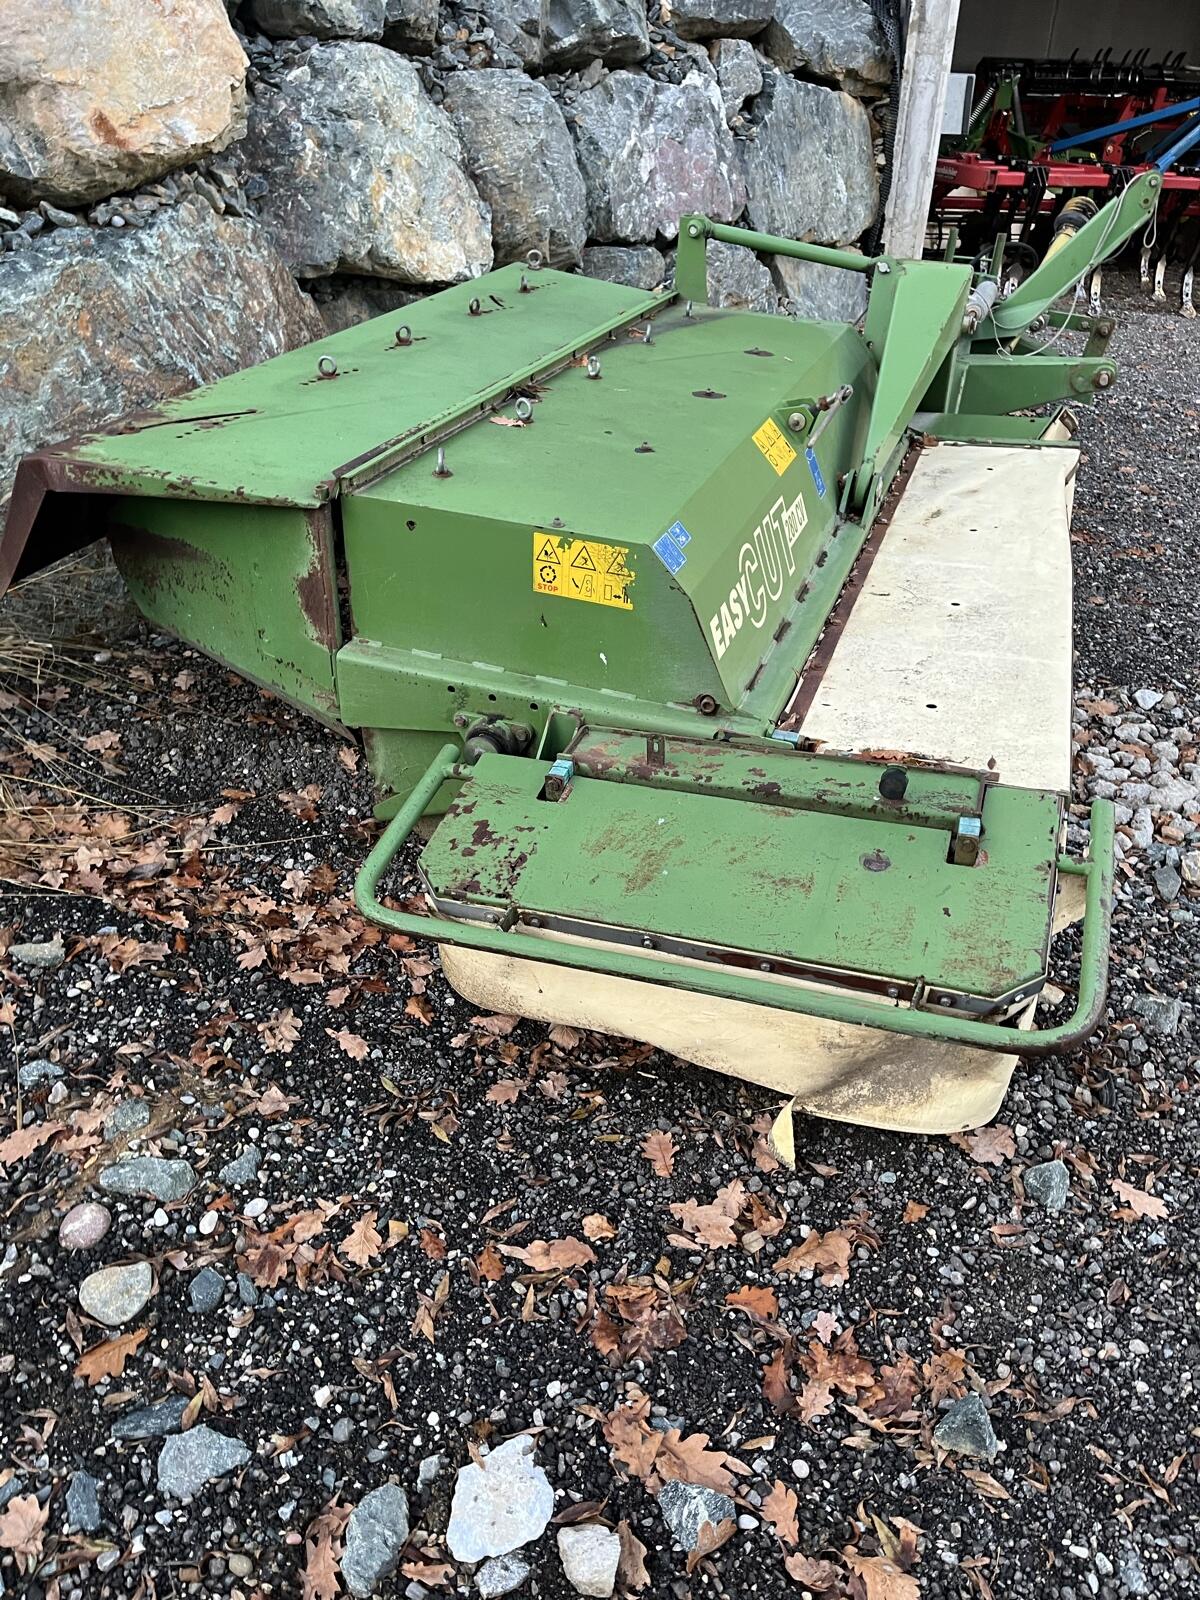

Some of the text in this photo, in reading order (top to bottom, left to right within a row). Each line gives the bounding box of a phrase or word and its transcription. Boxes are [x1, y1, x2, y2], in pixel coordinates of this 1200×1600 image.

[784, 500, 806, 543] 280 CV
[537, 583, 559, 592] STOP
